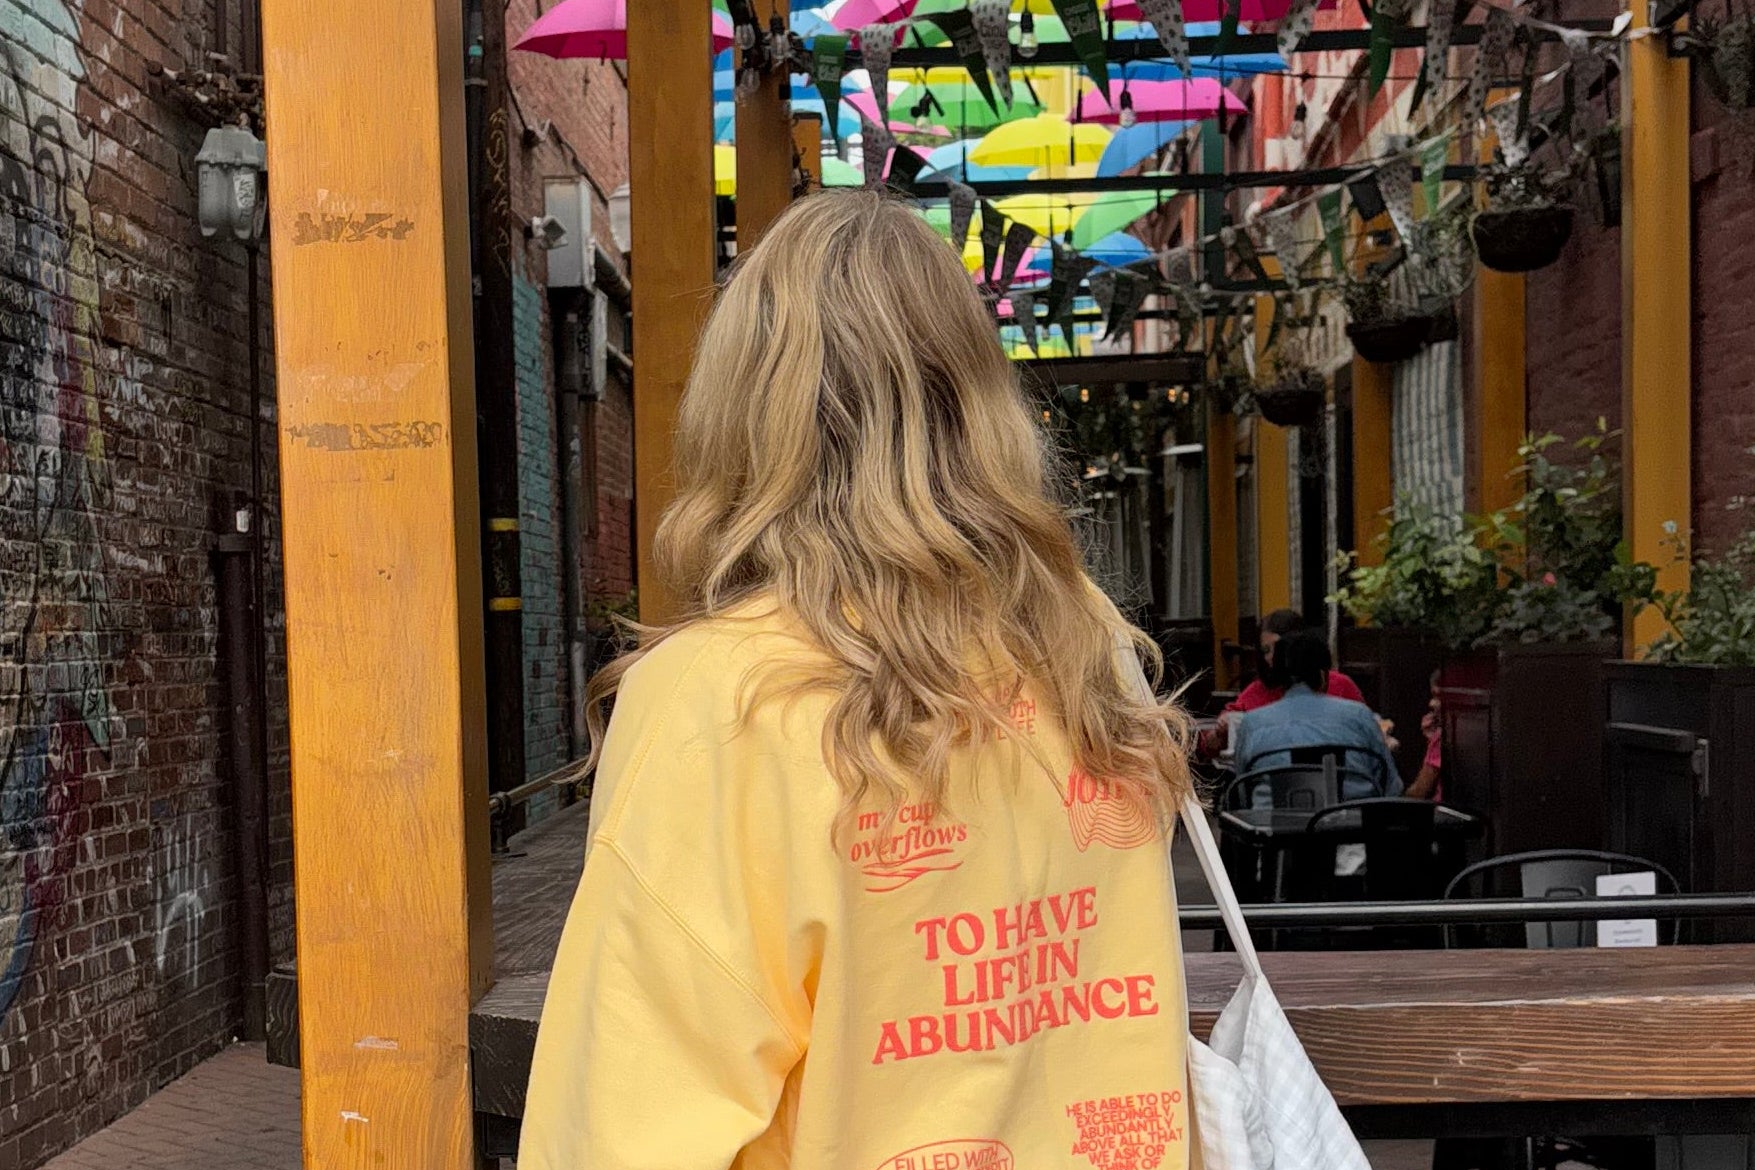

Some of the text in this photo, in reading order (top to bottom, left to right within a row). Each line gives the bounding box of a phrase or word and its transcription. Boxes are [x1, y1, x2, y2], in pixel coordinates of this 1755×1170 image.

[858, 801, 934, 832] m cup
[915, 886, 1098, 961] TO HAVE
[942, 938, 1080, 1007] LIFE IN
[872, 975, 1160, 1065] ABUNDANCE
[1066, 1091, 1181, 1118] HE IS ABLE TO DO
[1076, 1104, 1170, 1129] EXCEEDINGLY
[1080, 1112, 1174, 1140] ABUNDANTLY
[964, 1142, 1000, 1168] WITH
[1072, 1128, 1183, 1155] ABOVE ALL THAT
[1088, 1144, 1166, 1165] WE ASK OR
[1141, 1156, 1161, 1170] OF
